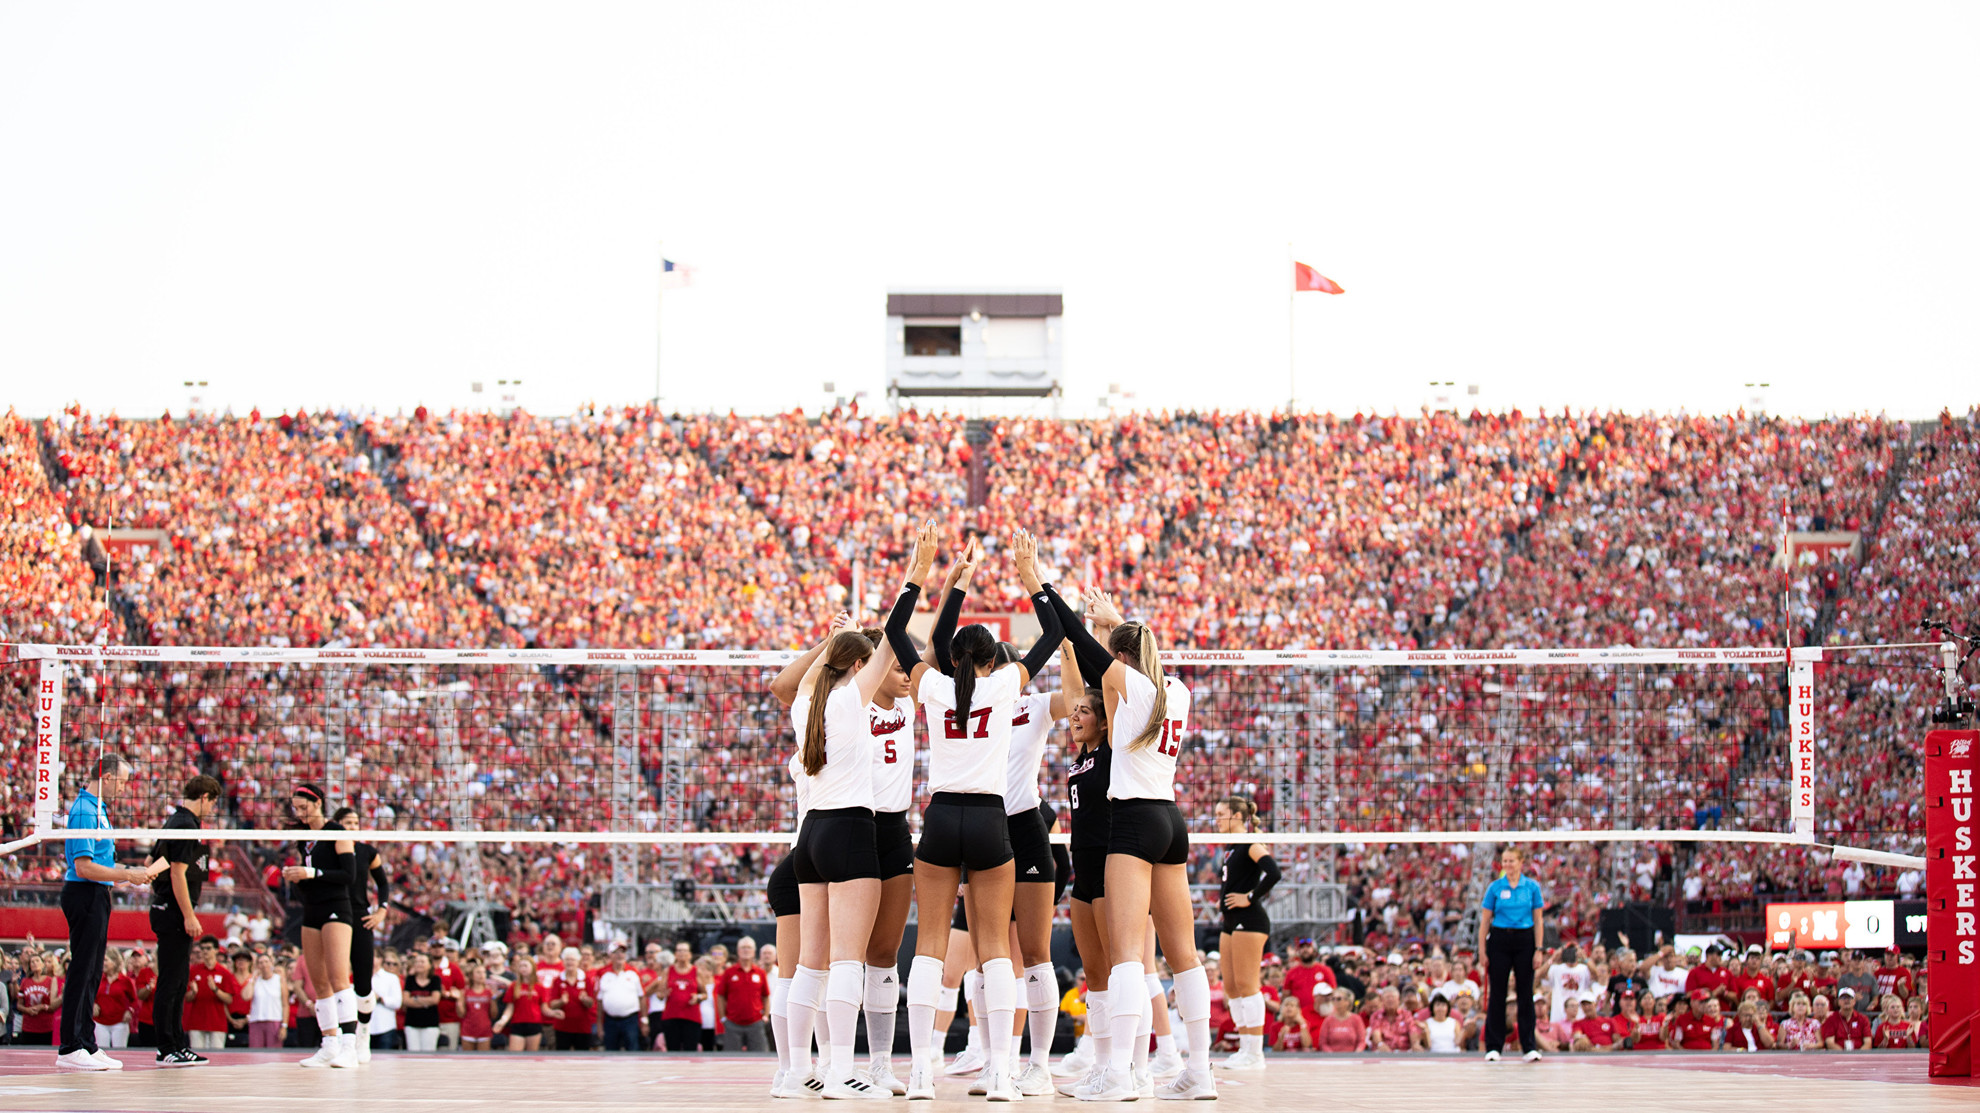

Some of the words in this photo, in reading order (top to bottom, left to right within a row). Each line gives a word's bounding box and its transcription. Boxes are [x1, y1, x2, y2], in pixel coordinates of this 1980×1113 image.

[363, 651, 427, 659] VOLLEYBALL
[633, 652, 697, 661] VOLLEYBALL
[1180, 652, 1245, 661] VOLLEYBALL
[1453, 652, 1518, 660] VOLLEYBALL
[1723, 650, 1785, 659] VOLLEYBALL
[944, 706, 993, 739] 27
[38, 680, 54, 800] HUSKERS
[1157, 718, 1183, 757] 15
[1798, 685, 1812, 807] HUSKERS
[884, 739, 898, 764] 5
[1070, 784, 1080, 810] 8
[1949, 769, 1977, 965] HUSKERS
